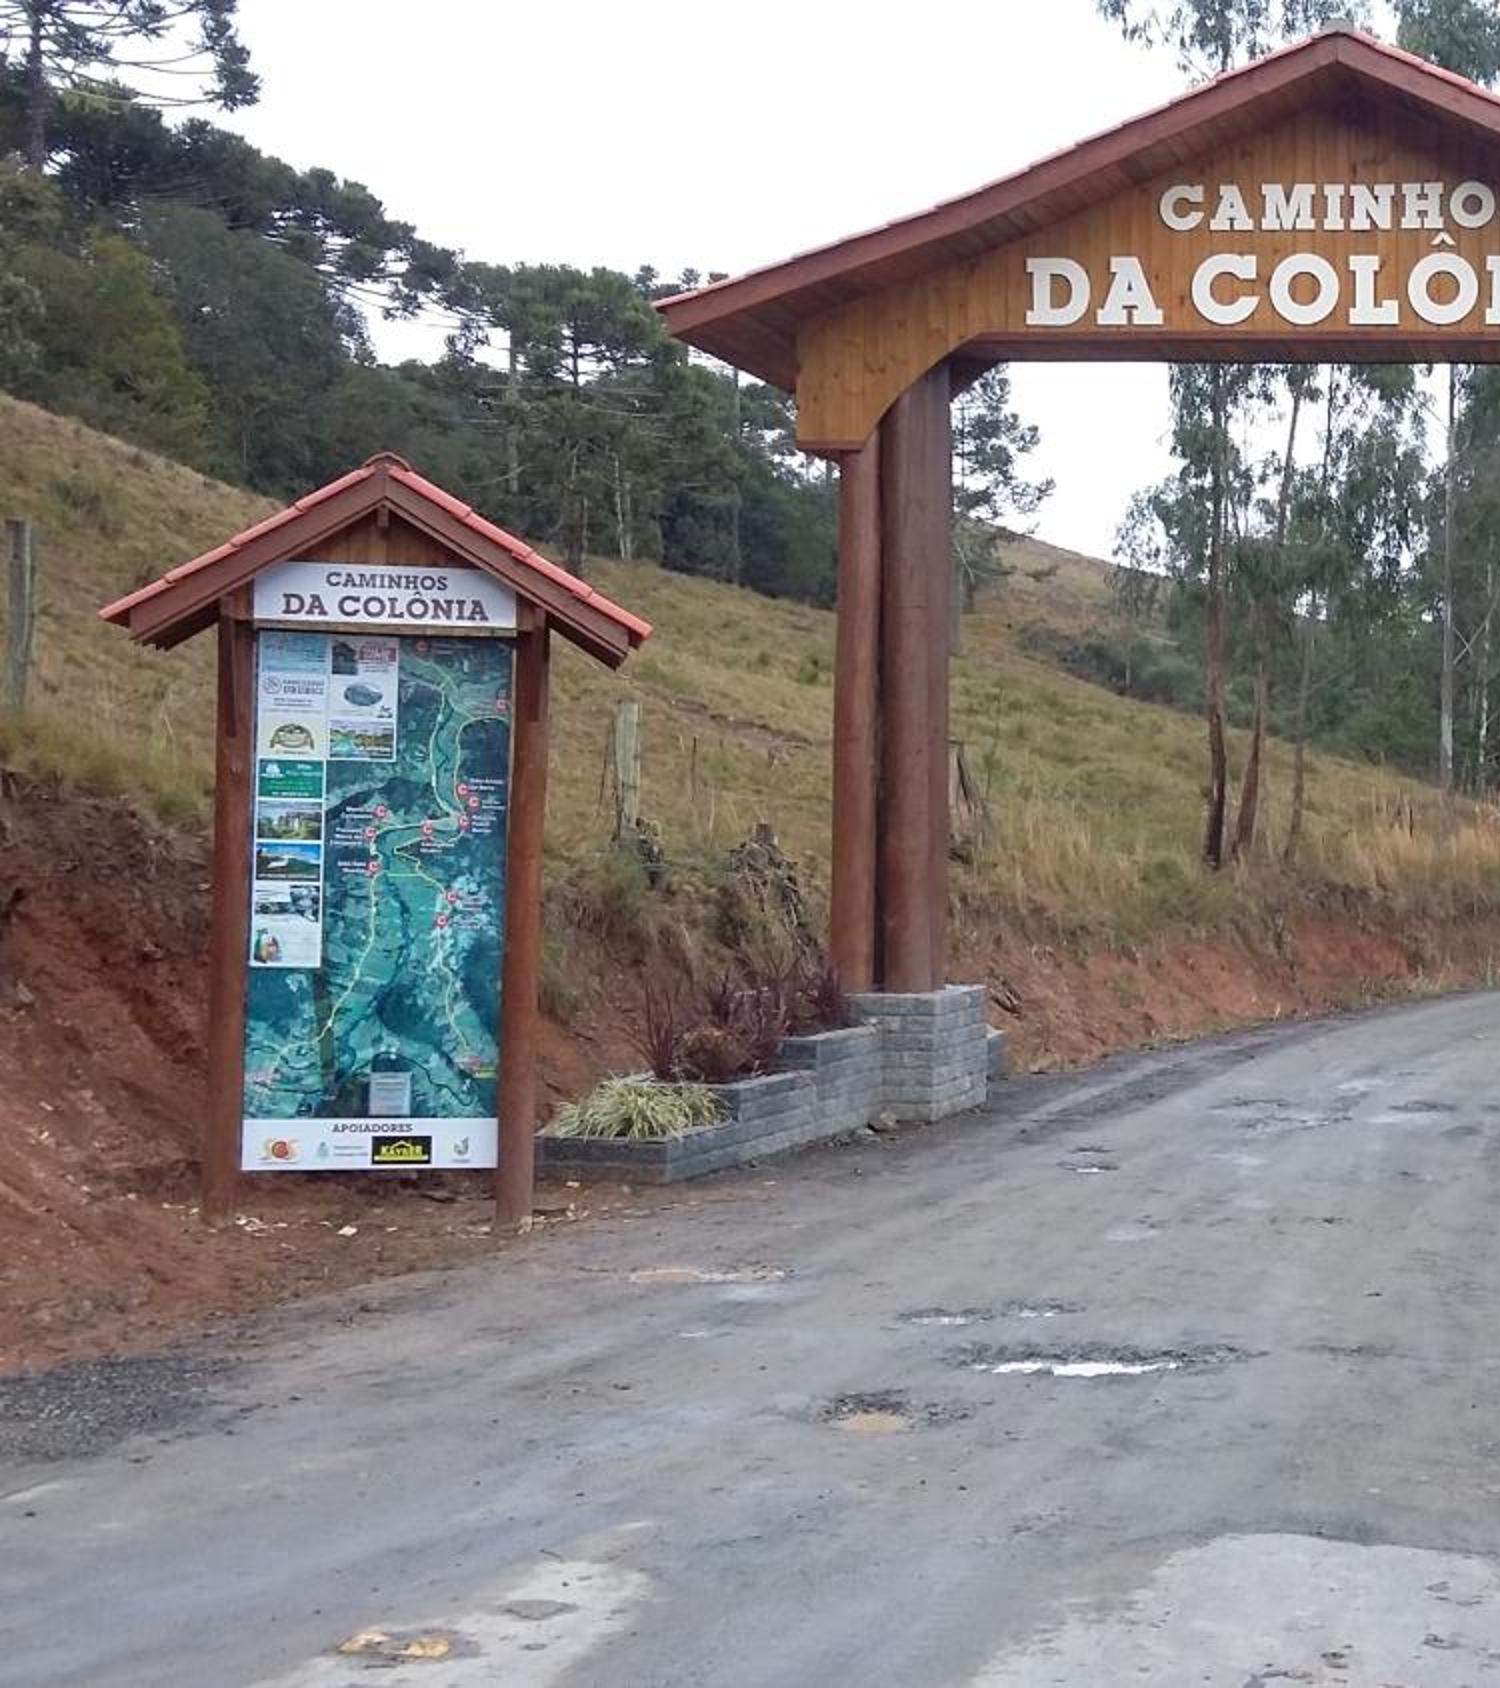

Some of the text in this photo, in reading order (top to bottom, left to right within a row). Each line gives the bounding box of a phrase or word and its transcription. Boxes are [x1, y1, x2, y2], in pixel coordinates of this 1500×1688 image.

[1025, 256, 1165, 327] DA
[325, 571, 449, 592] CAMINHOS
[282, 592, 490, 622] DA COLÔNIA
[331, 1123, 414, 1135] APOIADORES
